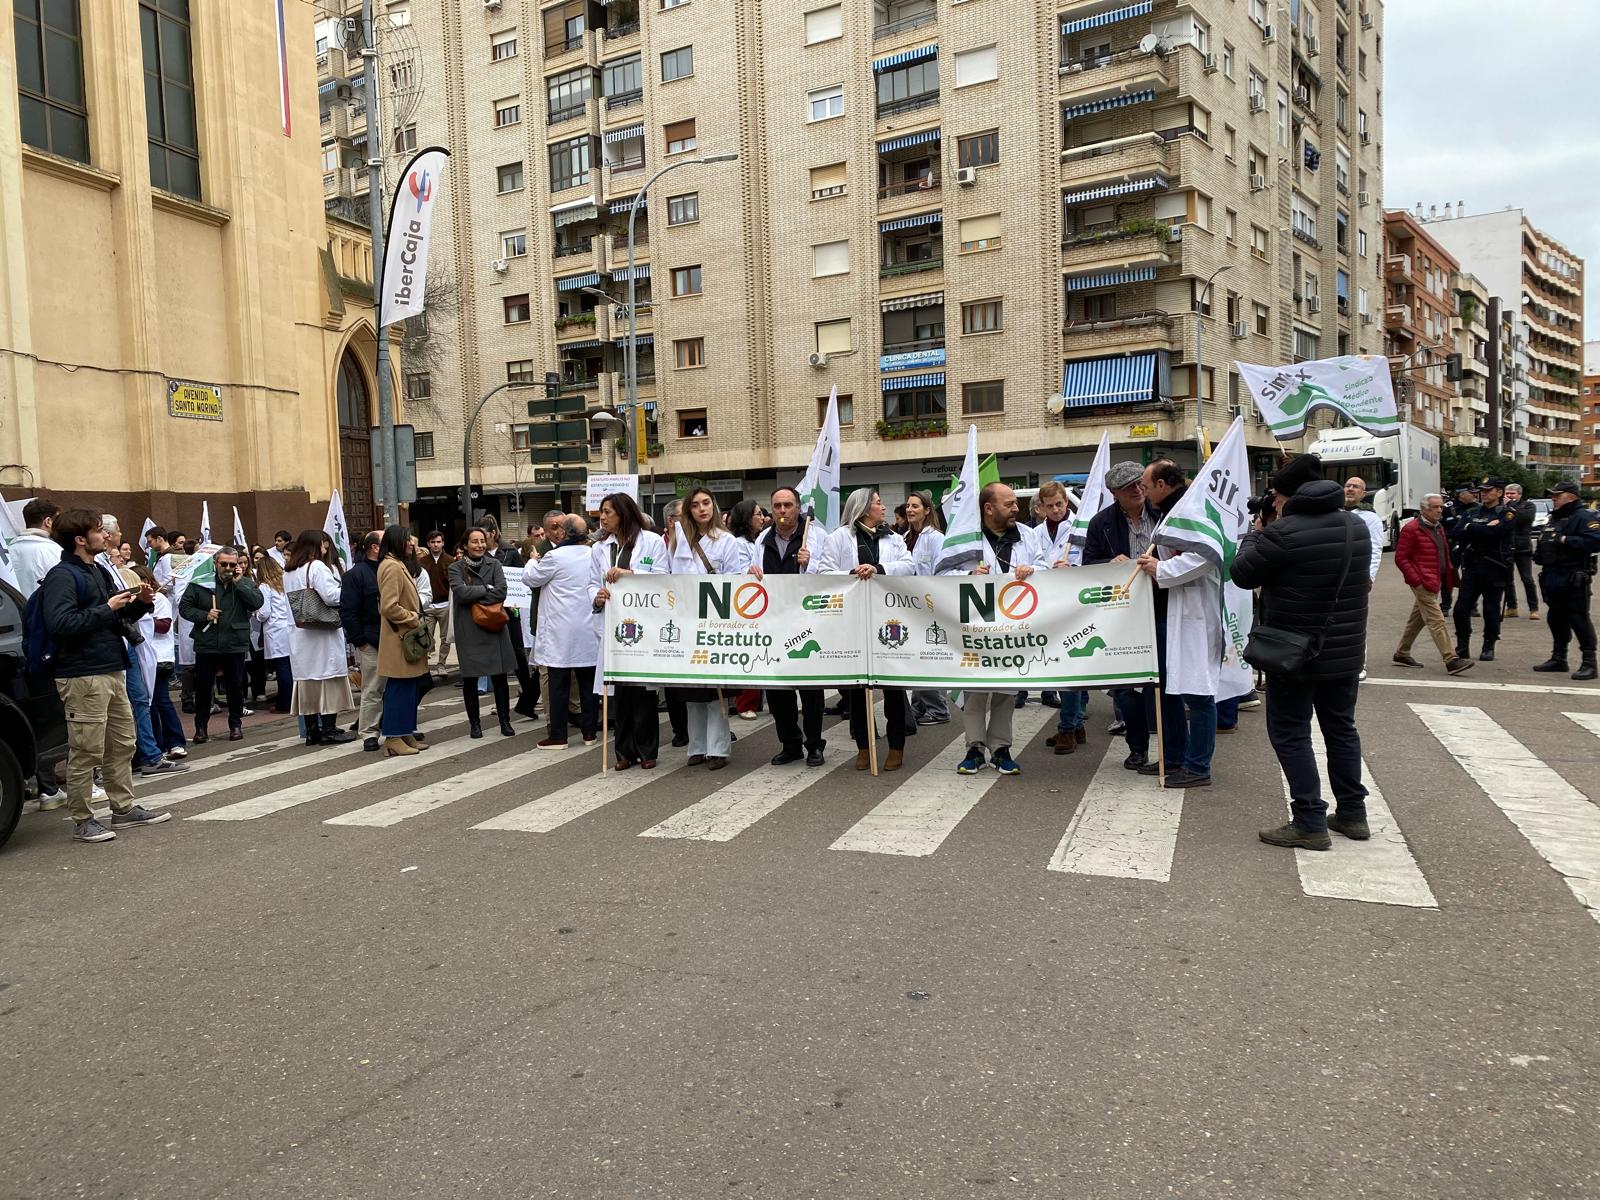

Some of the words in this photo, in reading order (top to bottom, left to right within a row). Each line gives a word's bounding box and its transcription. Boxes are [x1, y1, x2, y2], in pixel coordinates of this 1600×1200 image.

[1261, 368, 1312, 400] simx
[184, 388, 208, 402] AVENIDA
[175, 400, 195, 412] SANTA
[196, 402, 218, 414] MARINA
[921, 464, 957, 474] Carrefour
[622, 592, 662, 608] OMC
[884, 592, 922, 610] OMC
[698, 620, 706, 628] al
[709, 620, 746, 629] borrador
[962, 624, 969, 632] al
[972, 624, 1014, 633] borrador
[1018, 621, 1030, 630] de
[696, 630, 773, 647] Estatuto
[784, 627, 813, 650] simex
[962, 632, 1048, 650] Estatuto
[1062, 623, 1096, 648] simex
[690, 650, 750, 666] Marco
[960, 652, 1026, 668] Marco
